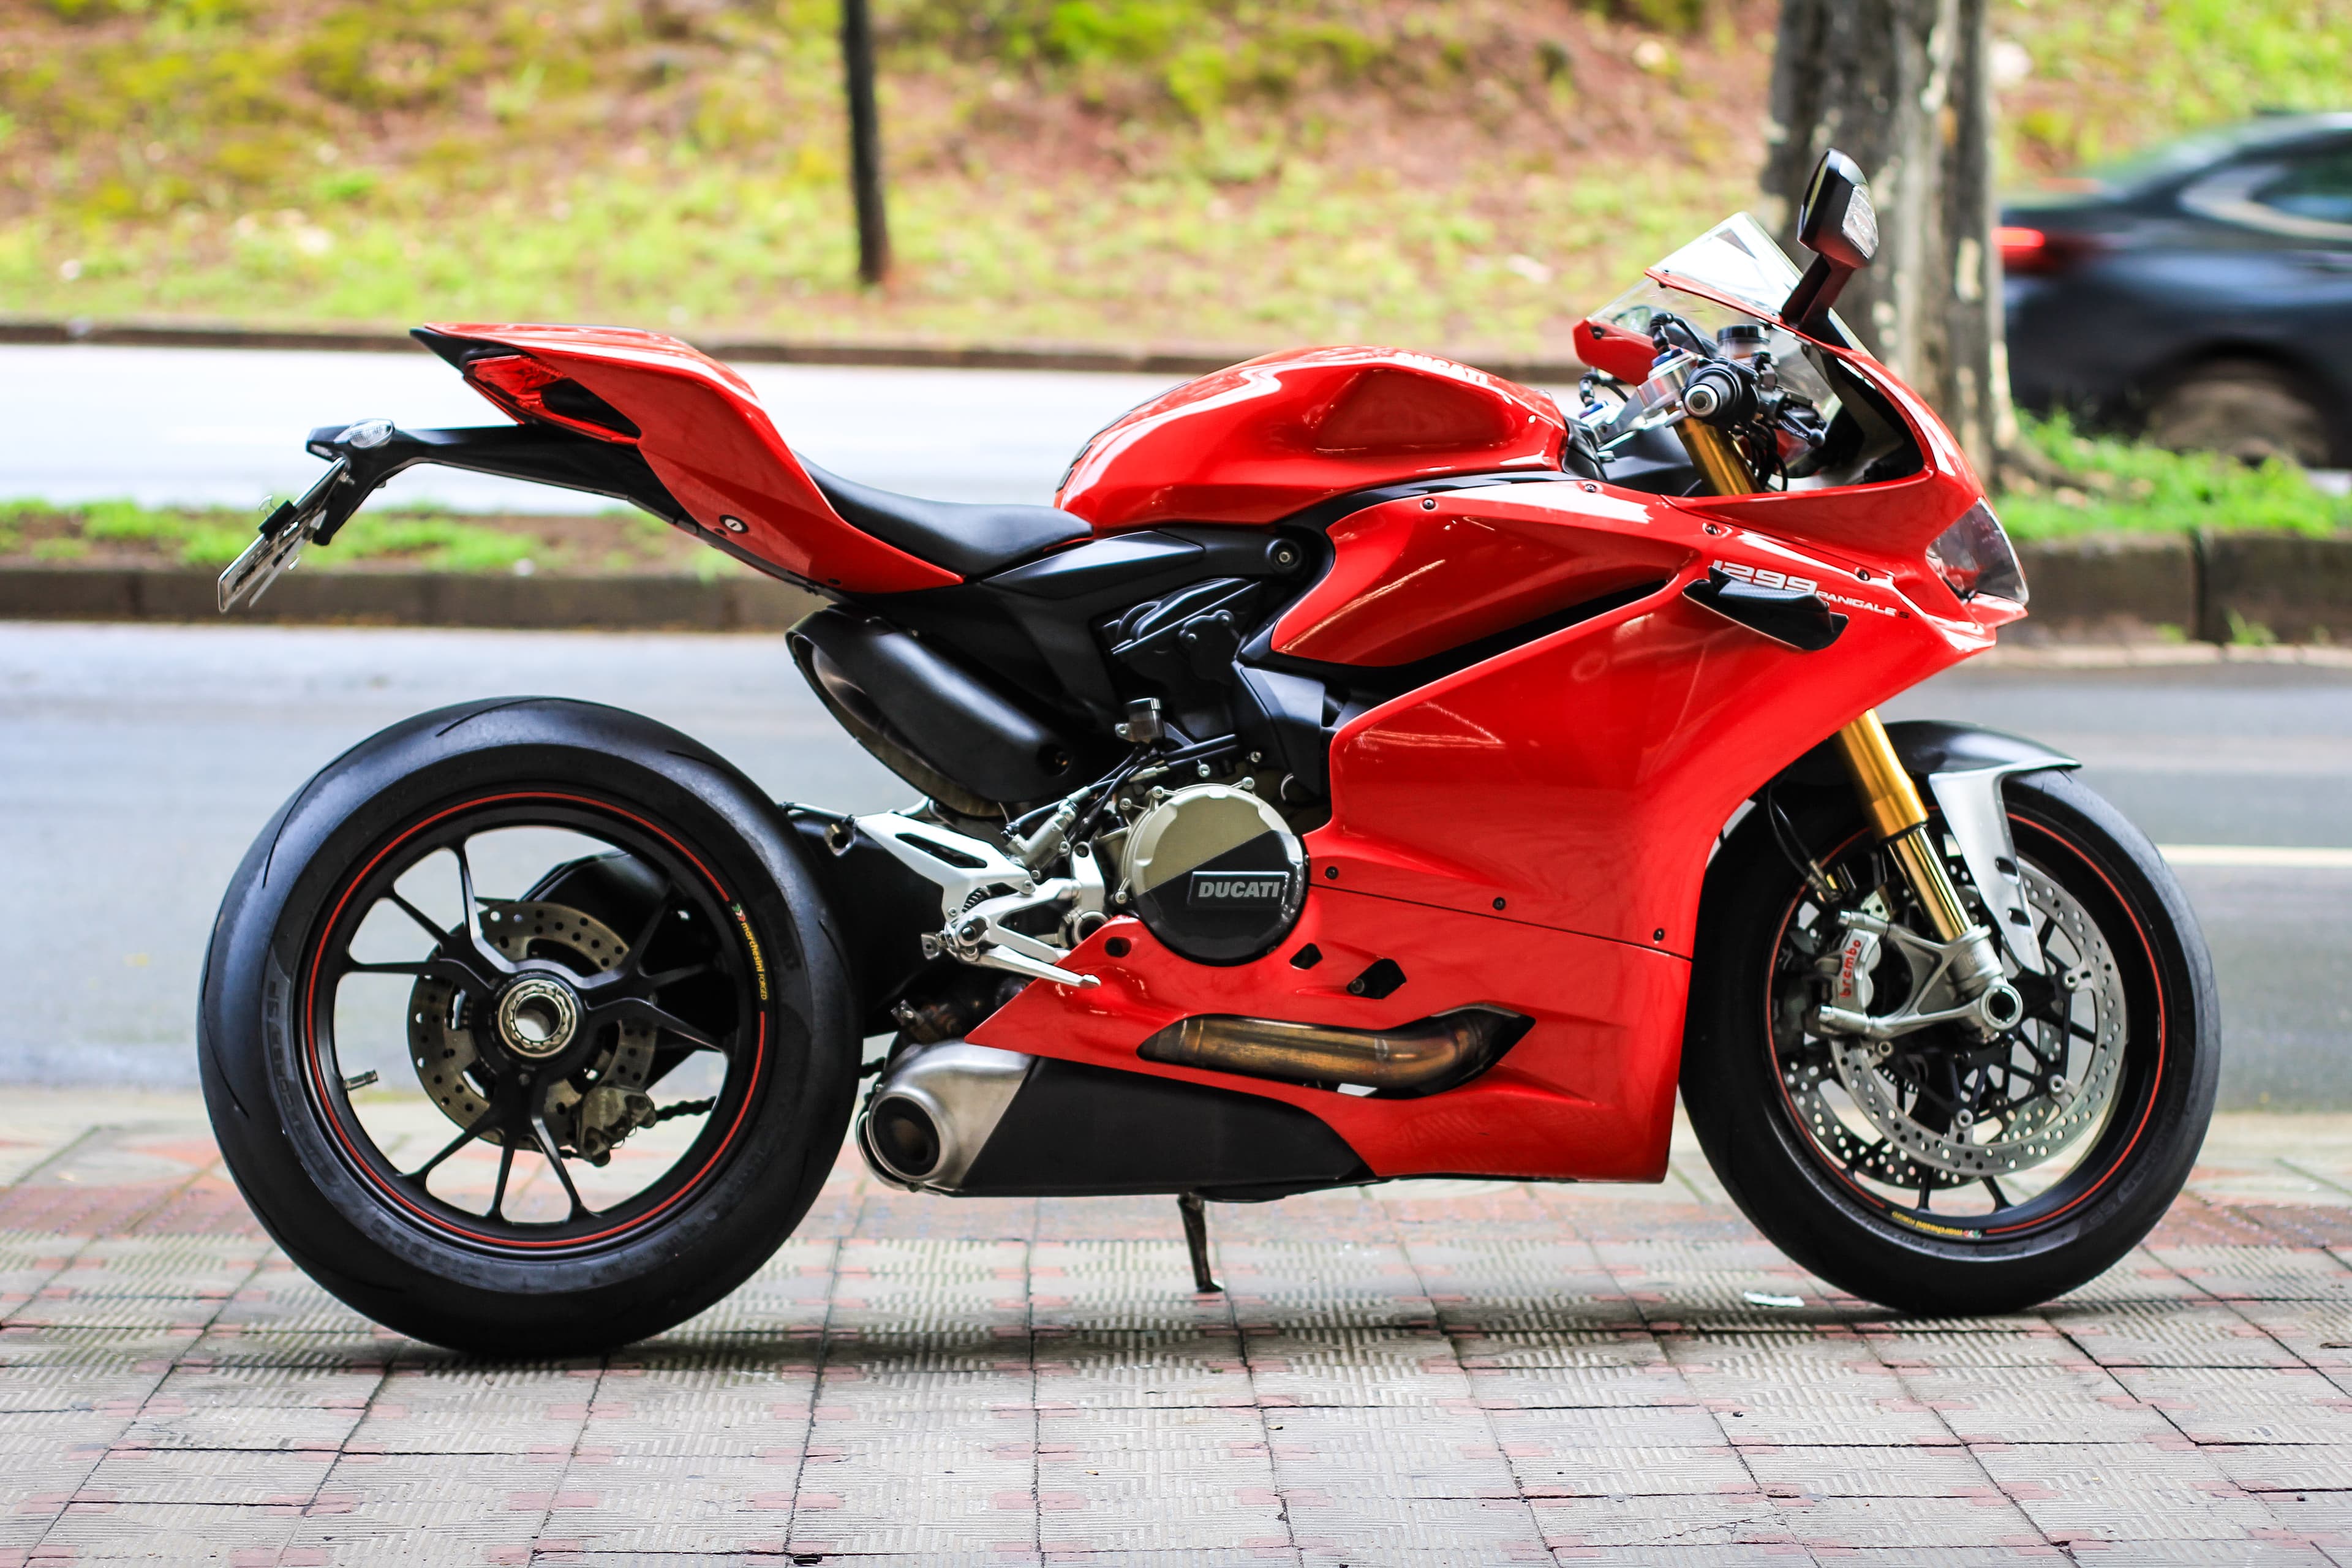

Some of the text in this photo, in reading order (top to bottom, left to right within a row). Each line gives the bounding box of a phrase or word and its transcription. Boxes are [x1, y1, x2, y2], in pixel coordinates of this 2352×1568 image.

[1395, 352, 1488, 385] DUCATI
[1817, 592, 1896, 617] PANIGALE
[1198, 881, 1280, 897] DUCATI
[741, 922, 767, 1000] marchesini FORGED
[1839, 940, 1861, 997] brembo
